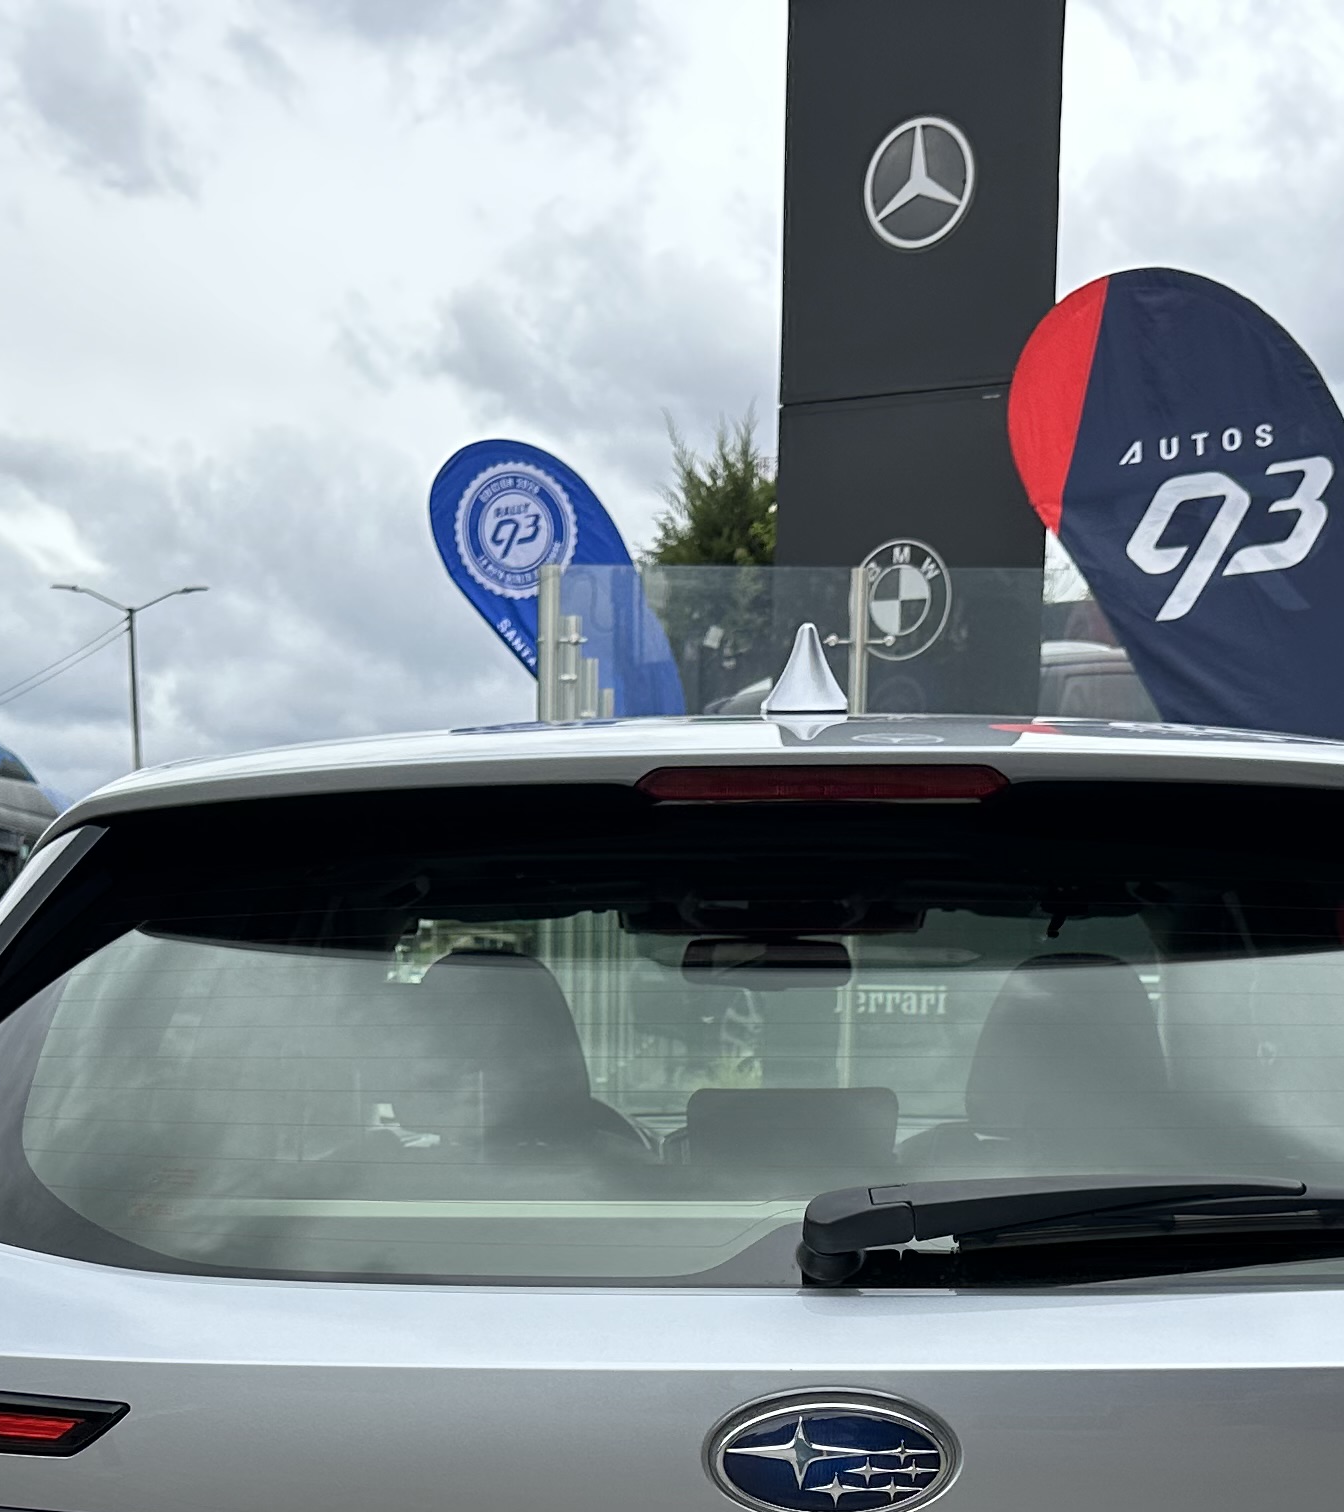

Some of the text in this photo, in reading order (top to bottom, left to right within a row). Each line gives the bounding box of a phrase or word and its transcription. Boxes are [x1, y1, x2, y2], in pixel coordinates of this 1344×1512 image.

[1118, 423, 1274, 466] AUTOS
[491, 514, 541, 559] 93
[1126, 456, 1334, 622] 93
[866, 546, 940, 582] BMW
